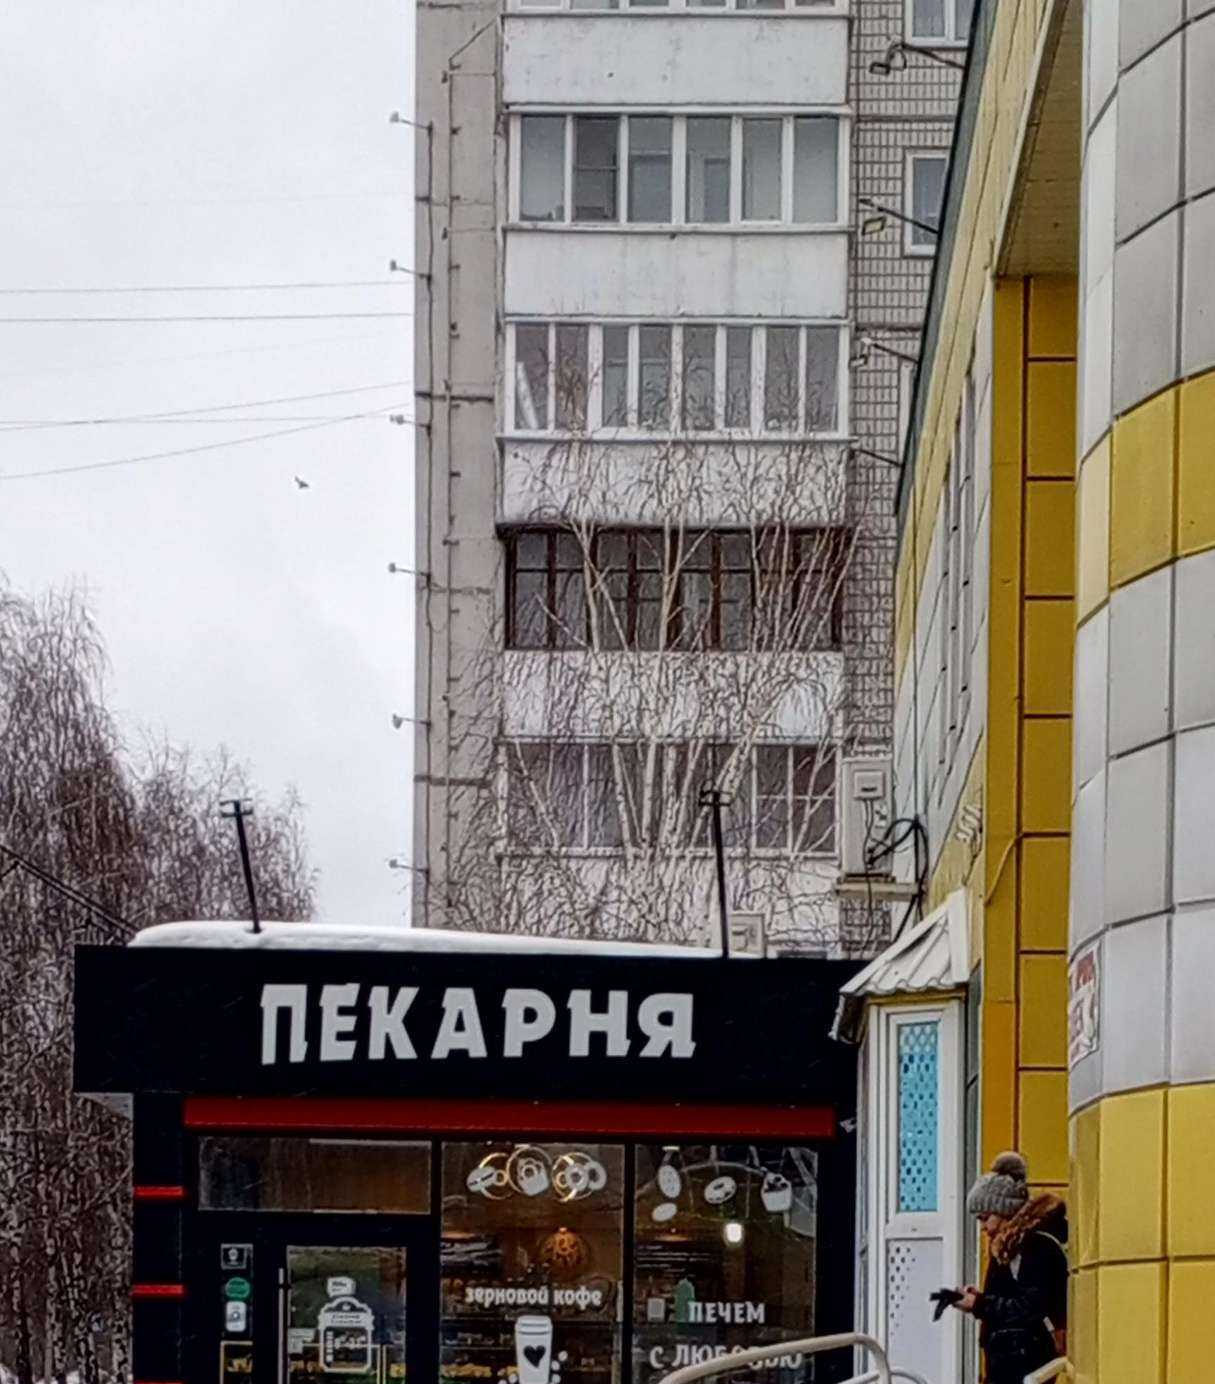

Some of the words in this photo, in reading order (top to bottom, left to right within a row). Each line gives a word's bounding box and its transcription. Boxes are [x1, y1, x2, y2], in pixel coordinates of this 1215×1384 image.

[260, 983, 696, 1065] ПЕКАРНЯ
[465, 1286, 549, 1308] зерновой
[554, 1286, 602, 1310] кофе
[688, 1301, 765, 1323] ПЕЧЕМ
